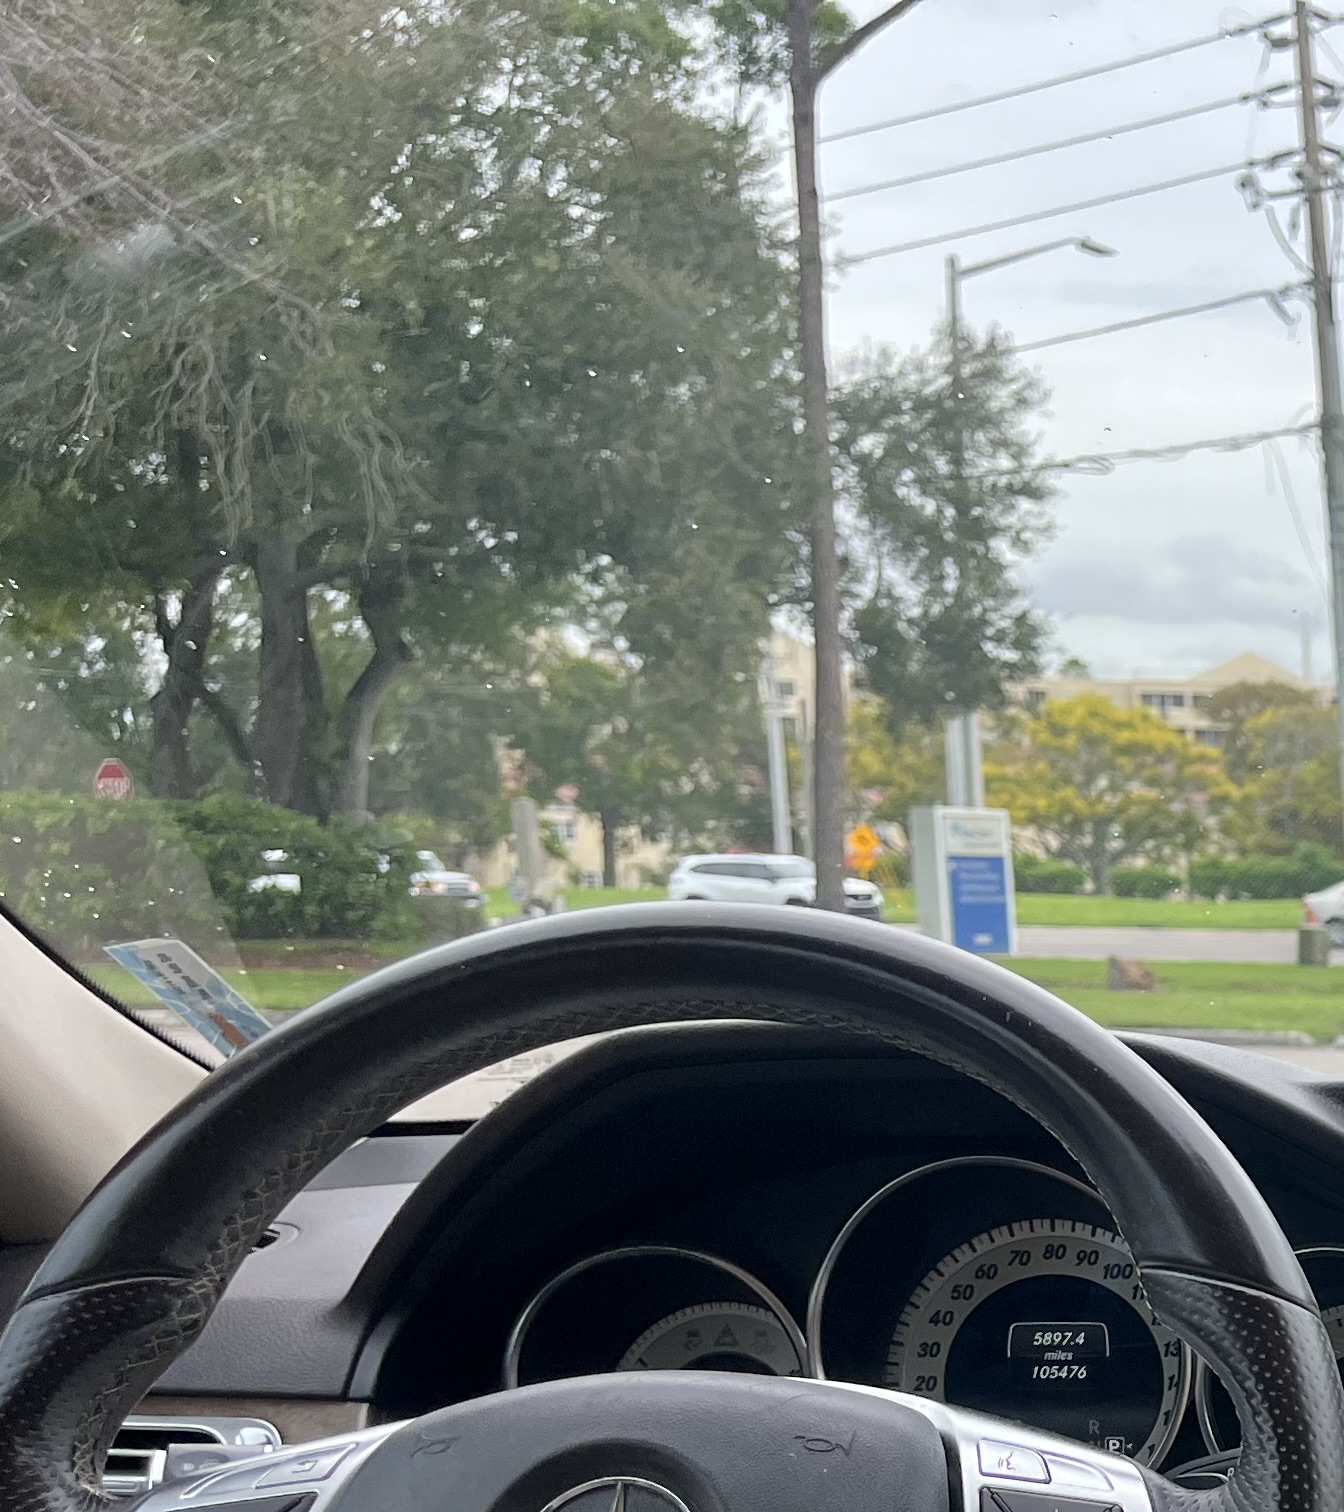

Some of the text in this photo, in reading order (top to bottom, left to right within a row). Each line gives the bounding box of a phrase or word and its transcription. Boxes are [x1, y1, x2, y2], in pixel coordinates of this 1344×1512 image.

[1007, 1250, 1032, 1267] 70
[1042, 1244, 1067, 1260] 80
[1075, 1250, 1100, 1267] 90
[974, 1264, 998, 1281] 60
[1102, 1263, 1134, 1280] 100
[950, 1284, 975, 1301] 50
[928, 1310, 954, 1326] 40
[1033, 1332, 1086, 1346] 5897.4
[916, 1342, 941, 1358] 30
[1043, 1350, 1074, 1361] miles
[1031, 1366, 1087, 1380] 105476
[912, 1376, 938, 1393] 20
[1108, 1439, 1121, 1453] P
